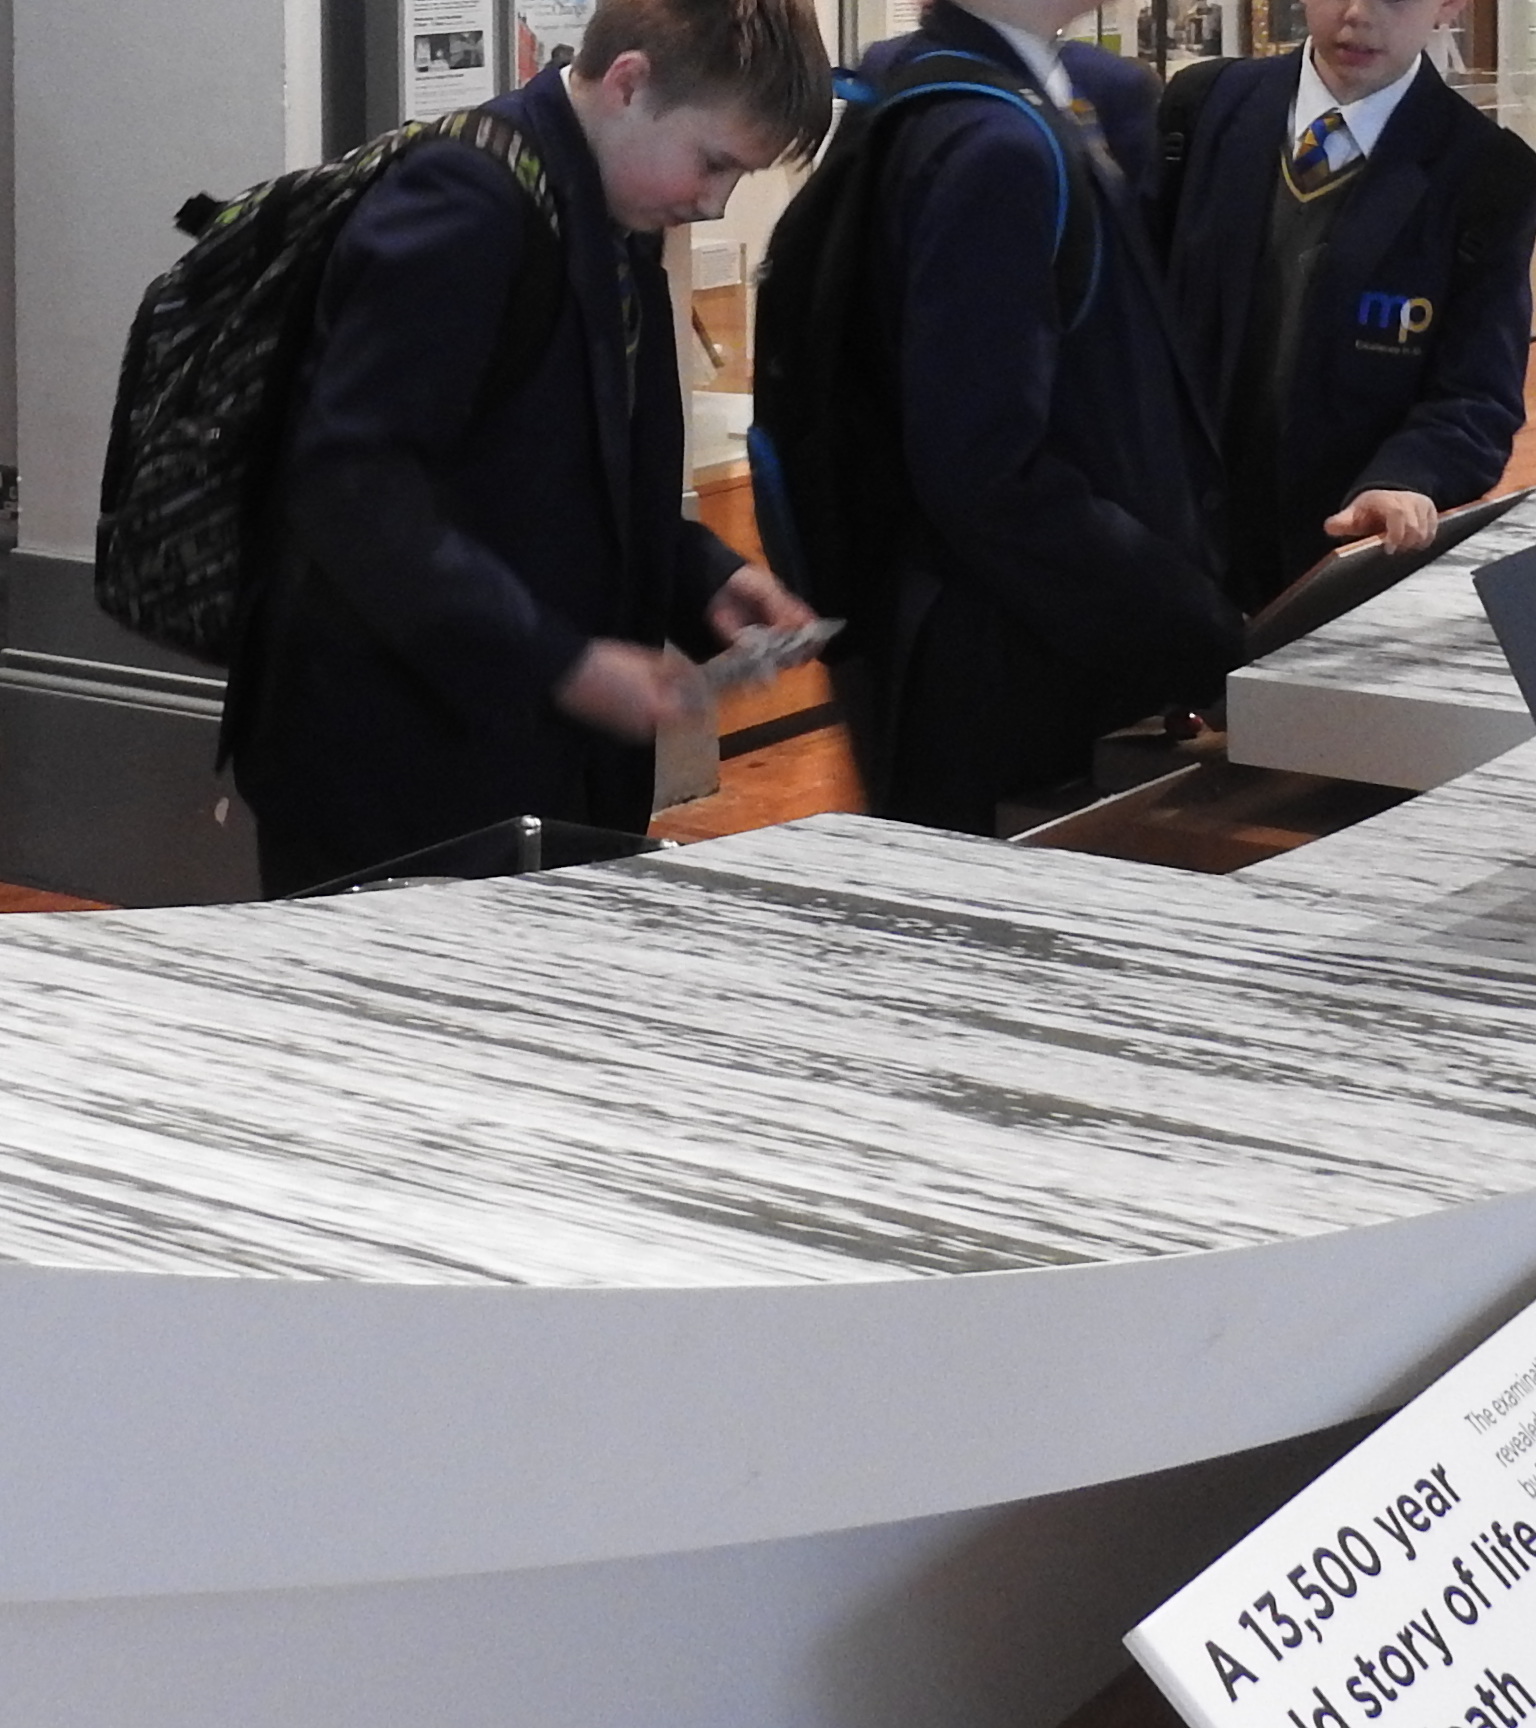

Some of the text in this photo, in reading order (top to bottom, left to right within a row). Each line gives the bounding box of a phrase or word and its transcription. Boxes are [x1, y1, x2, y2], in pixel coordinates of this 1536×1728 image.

[1357, 290, 1433, 344] mp
[1463, 1407, 1497, 1434] The
[1205, 1462, 1461, 1703] A 13,500 year
[1346, 1608, 1453, 1719] story
[1443, 1556, 1492, 1625] of
